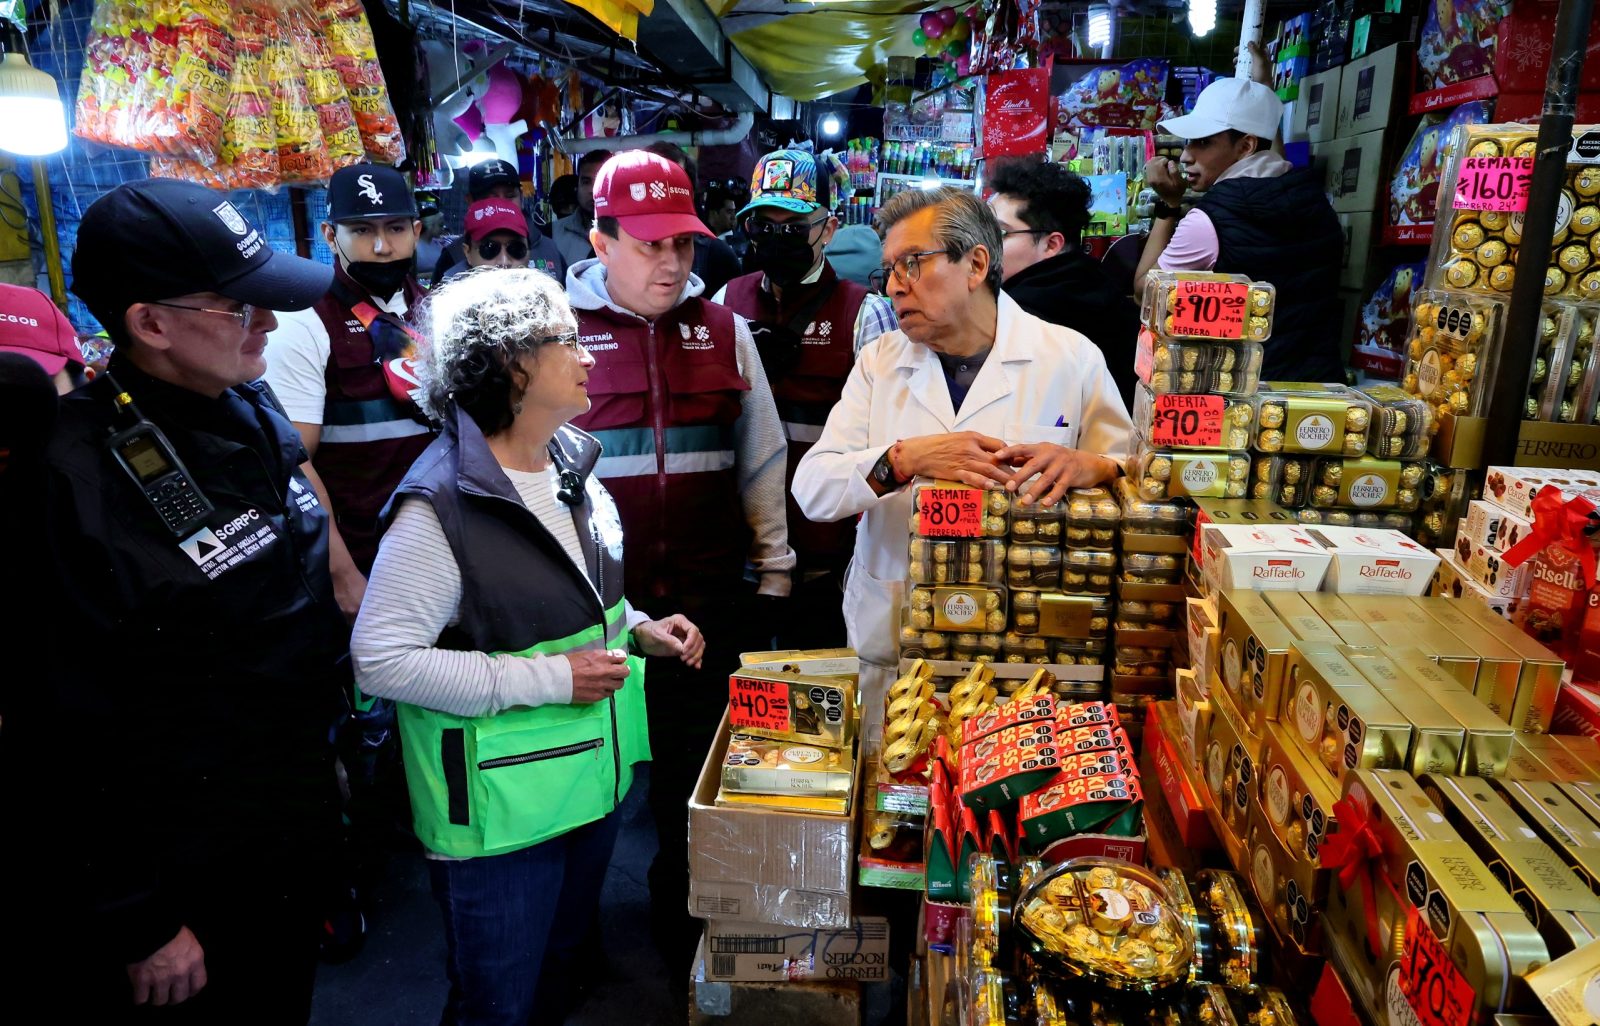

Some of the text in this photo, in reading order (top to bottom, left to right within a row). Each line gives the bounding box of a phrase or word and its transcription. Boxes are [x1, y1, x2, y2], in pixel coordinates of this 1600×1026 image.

[1466, 157, 1533, 170] REMATE
[1184, 282, 1232, 294] OFERTA
[1173, 326, 1210, 336] FERRERO
[1162, 395, 1208, 408] OFERTA
[1299, 426, 1330, 434] FERRERO
[1153, 438, 1190, 446] FERRERO
[1298, 432, 1330, 441] ROCHER
[1517, 440, 1597, 460] FERRERO
[1183, 475, 1213, 483] ROCHER
[1184, 469, 1214, 477] FERRERO
[931, 489, 971, 500] REMATE
[1352, 491, 1383, 499] ROCHER
[1353, 485, 1384, 493] FERRERO
[215, 508, 260, 540] SGIRPC
[1253, 566, 1305, 579] Raffaello
[1359, 565, 1412, 580] Raffaello
[1533, 560, 1585, 591] Giselle
[736, 679, 776, 694] REMATE
[827, 952, 886, 965] ROCHER
[826, 966, 885, 979] FERRERO
